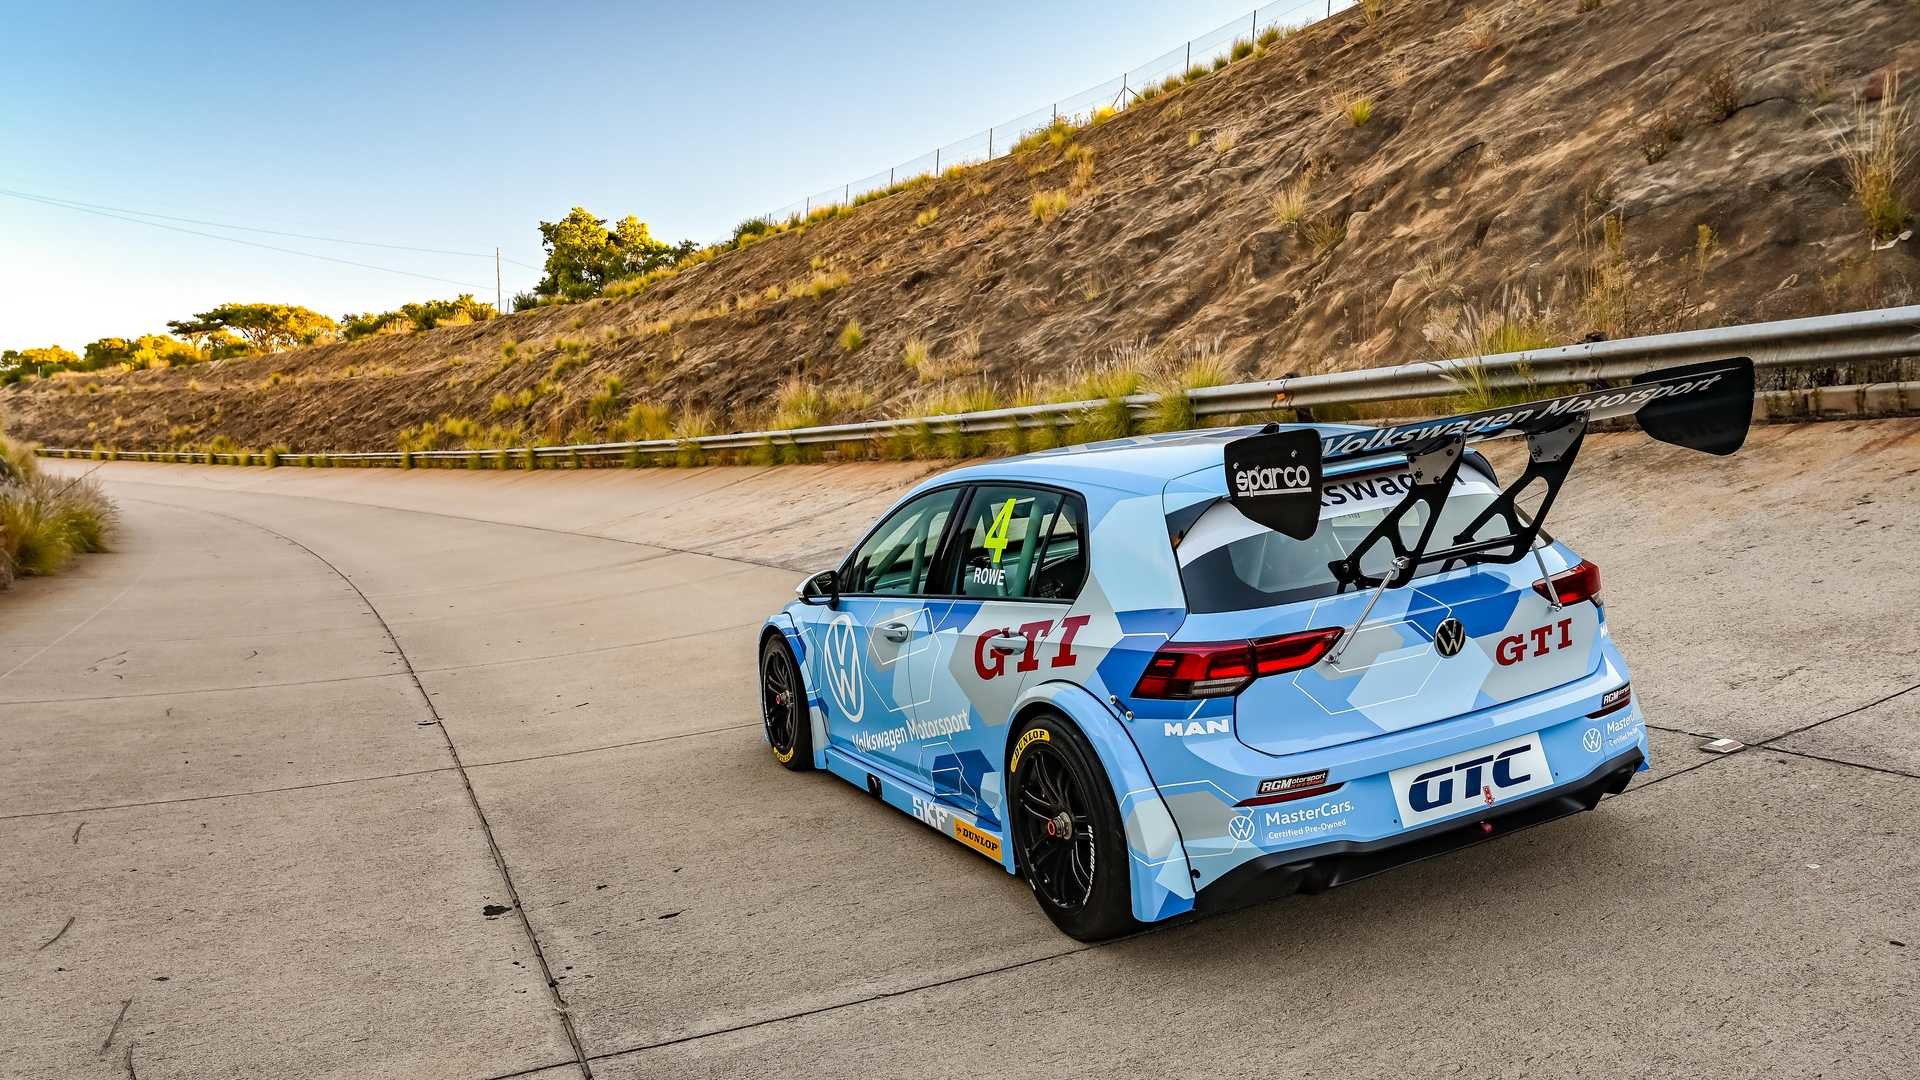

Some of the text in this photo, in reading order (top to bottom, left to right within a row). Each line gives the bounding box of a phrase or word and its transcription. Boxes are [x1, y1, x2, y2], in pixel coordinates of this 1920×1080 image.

[1321, 374, 1722, 457] Volkswagen Motorsport
[1236, 465, 1310, 497] sparco
[984, 498, 1016, 564] 4
[973, 567, 1006, 586] ROWE
[975, 615, 1091, 681] GTI
[1496, 618, 1573, 666] GTI
[852, 708, 972, 753] Volkswagen Motorsport
[1014, 730, 1046, 758] DUNLOP
[1164, 719, 1230, 737] MAN
[1409, 744, 1531, 812] GTC
[912, 796, 948, 831] SKF
[1268, 818, 1347, 840] Certified Pre-Owned
[963, 828, 998, 851] DUNLOP
